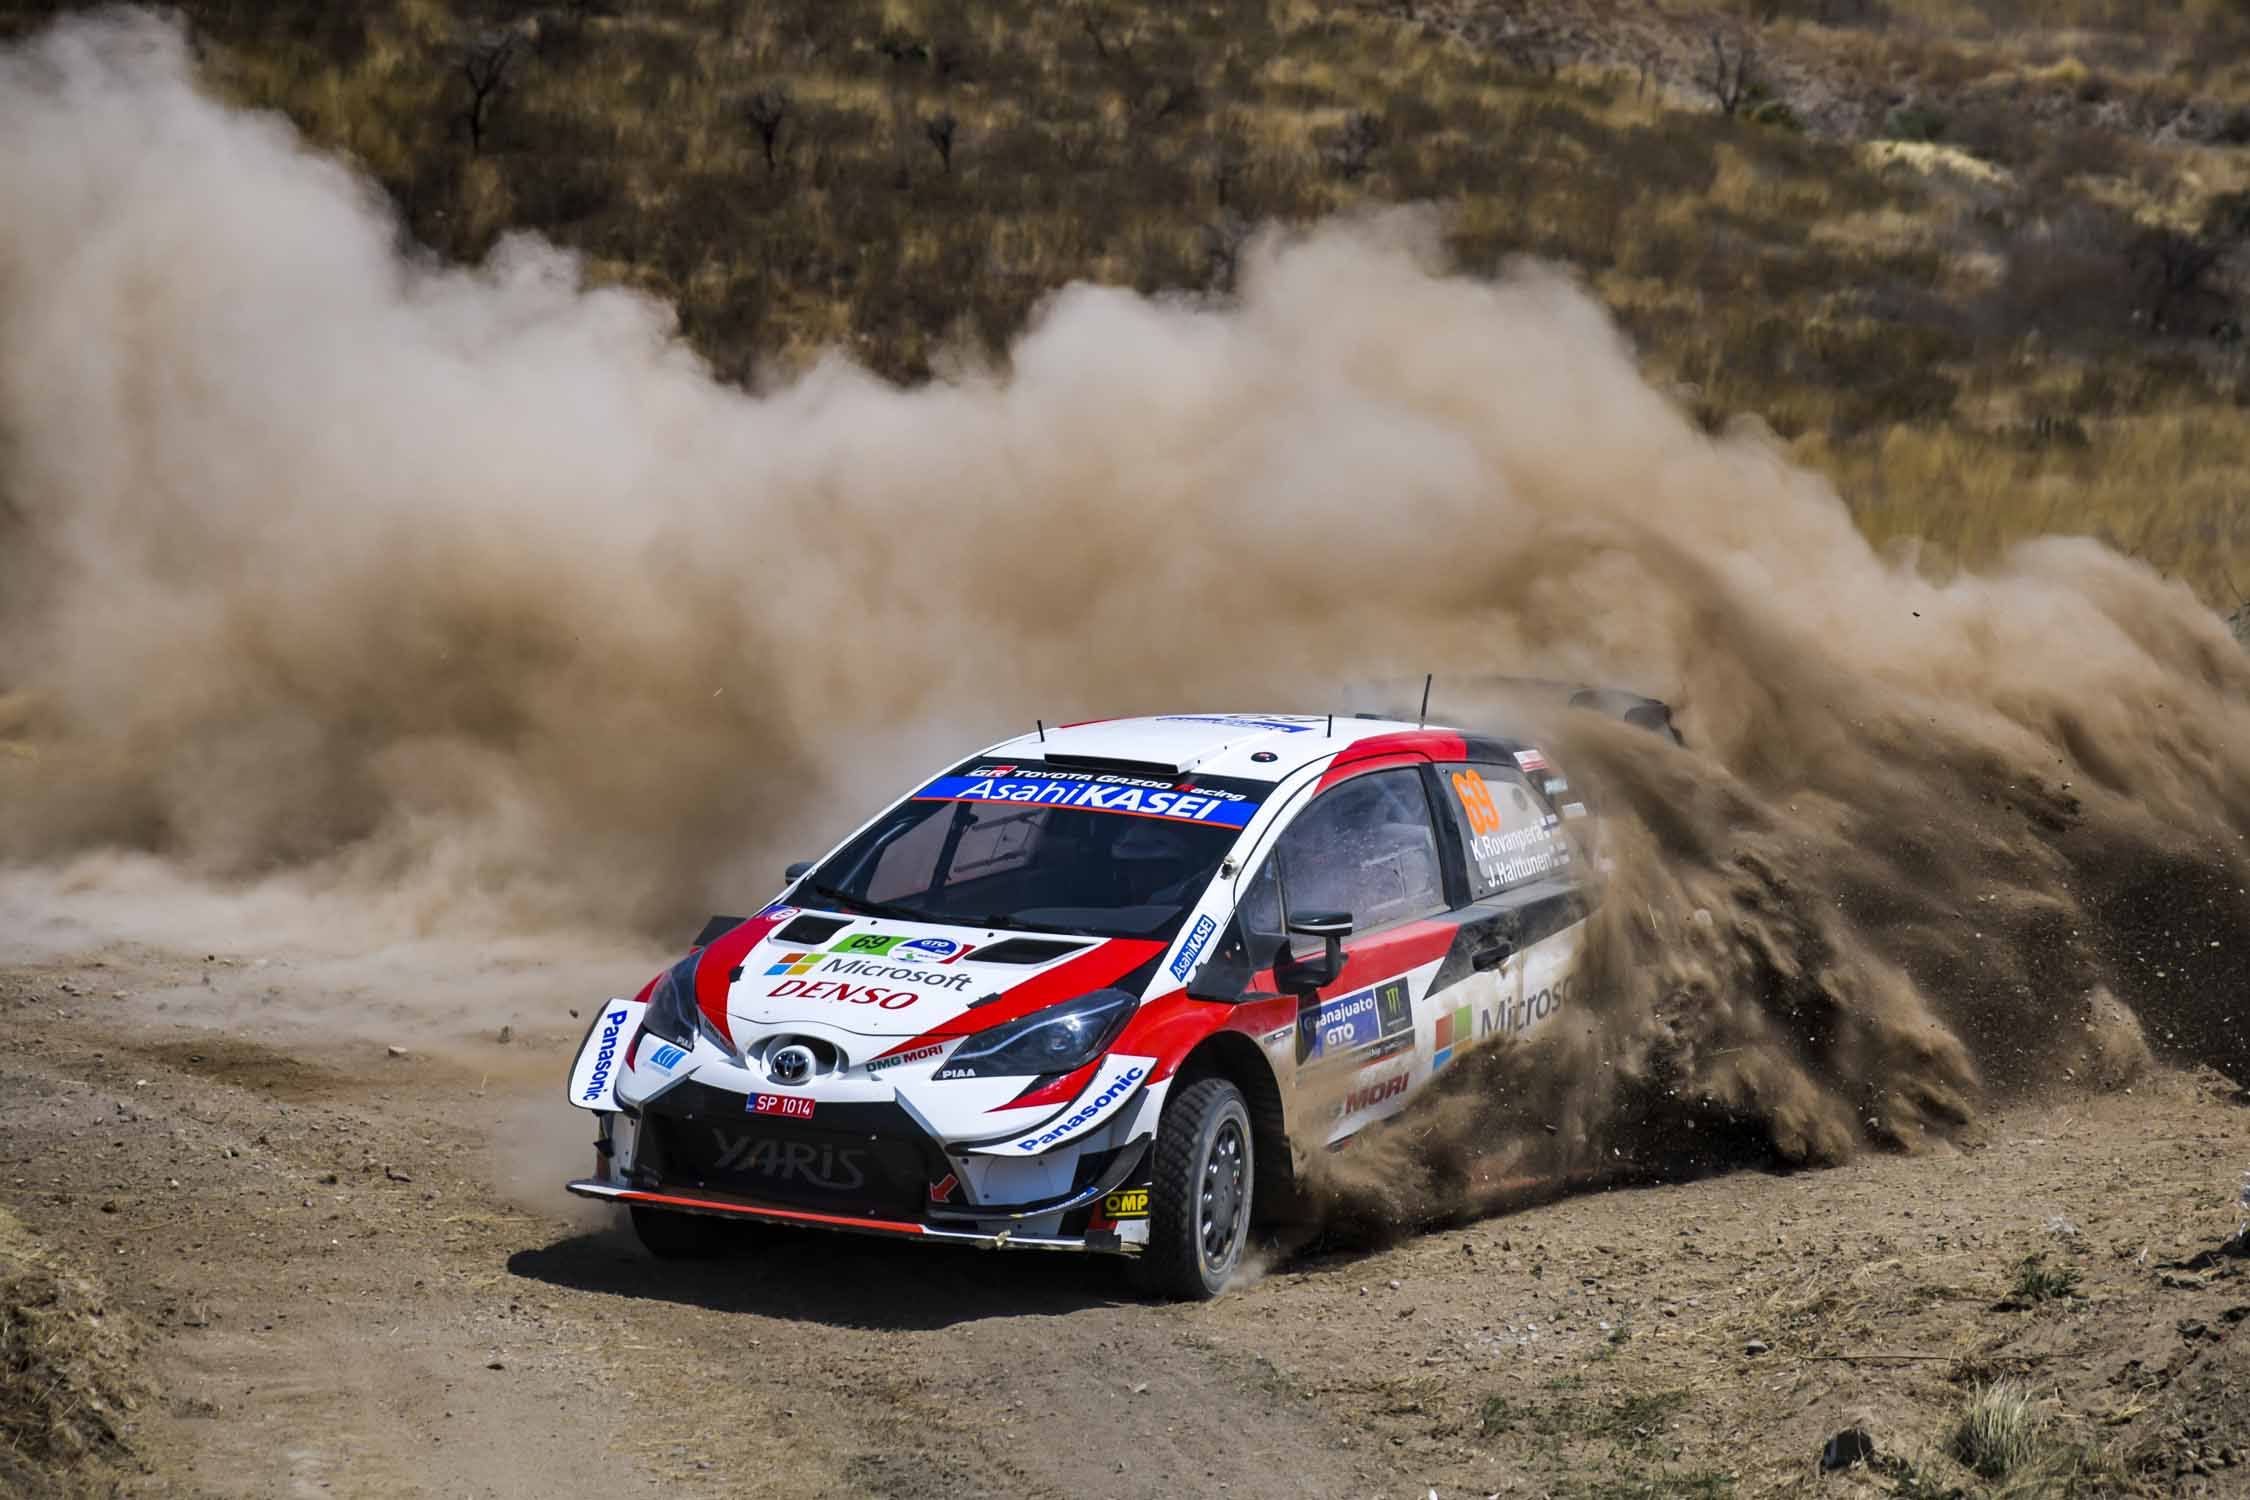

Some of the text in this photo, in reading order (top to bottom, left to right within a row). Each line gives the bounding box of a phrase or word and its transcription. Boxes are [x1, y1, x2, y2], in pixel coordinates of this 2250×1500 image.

[1014, 770, 1093, 781] TOYOTA
[1096, 775, 1173, 790] GAZOO
[1174, 783, 1247, 802] Racing
[1451, 768, 1500, 836] 69
[851, 935, 891, 949] 69
[822, 958, 973, 991] Microsoft
[766, 980, 919, 1010] DENSO
[1326, 1022, 1355, 1046] GTO
[582, 1010, 628, 1101] Panasonic
[865, 1045, 944, 1073] DMG MORI
[942, 1068, 976, 1078] PIAA
[757, 1095, 778, 1111] SP
[782, 1098, 811, 1115] 1014
[1017, 1066, 1144, 1151] Panasonic
[1345, 1072, 1409, 1114] MORI
[712, 1128, 865, 1190] YARIS
[1106, 1194, 1149, 1212] OMP
